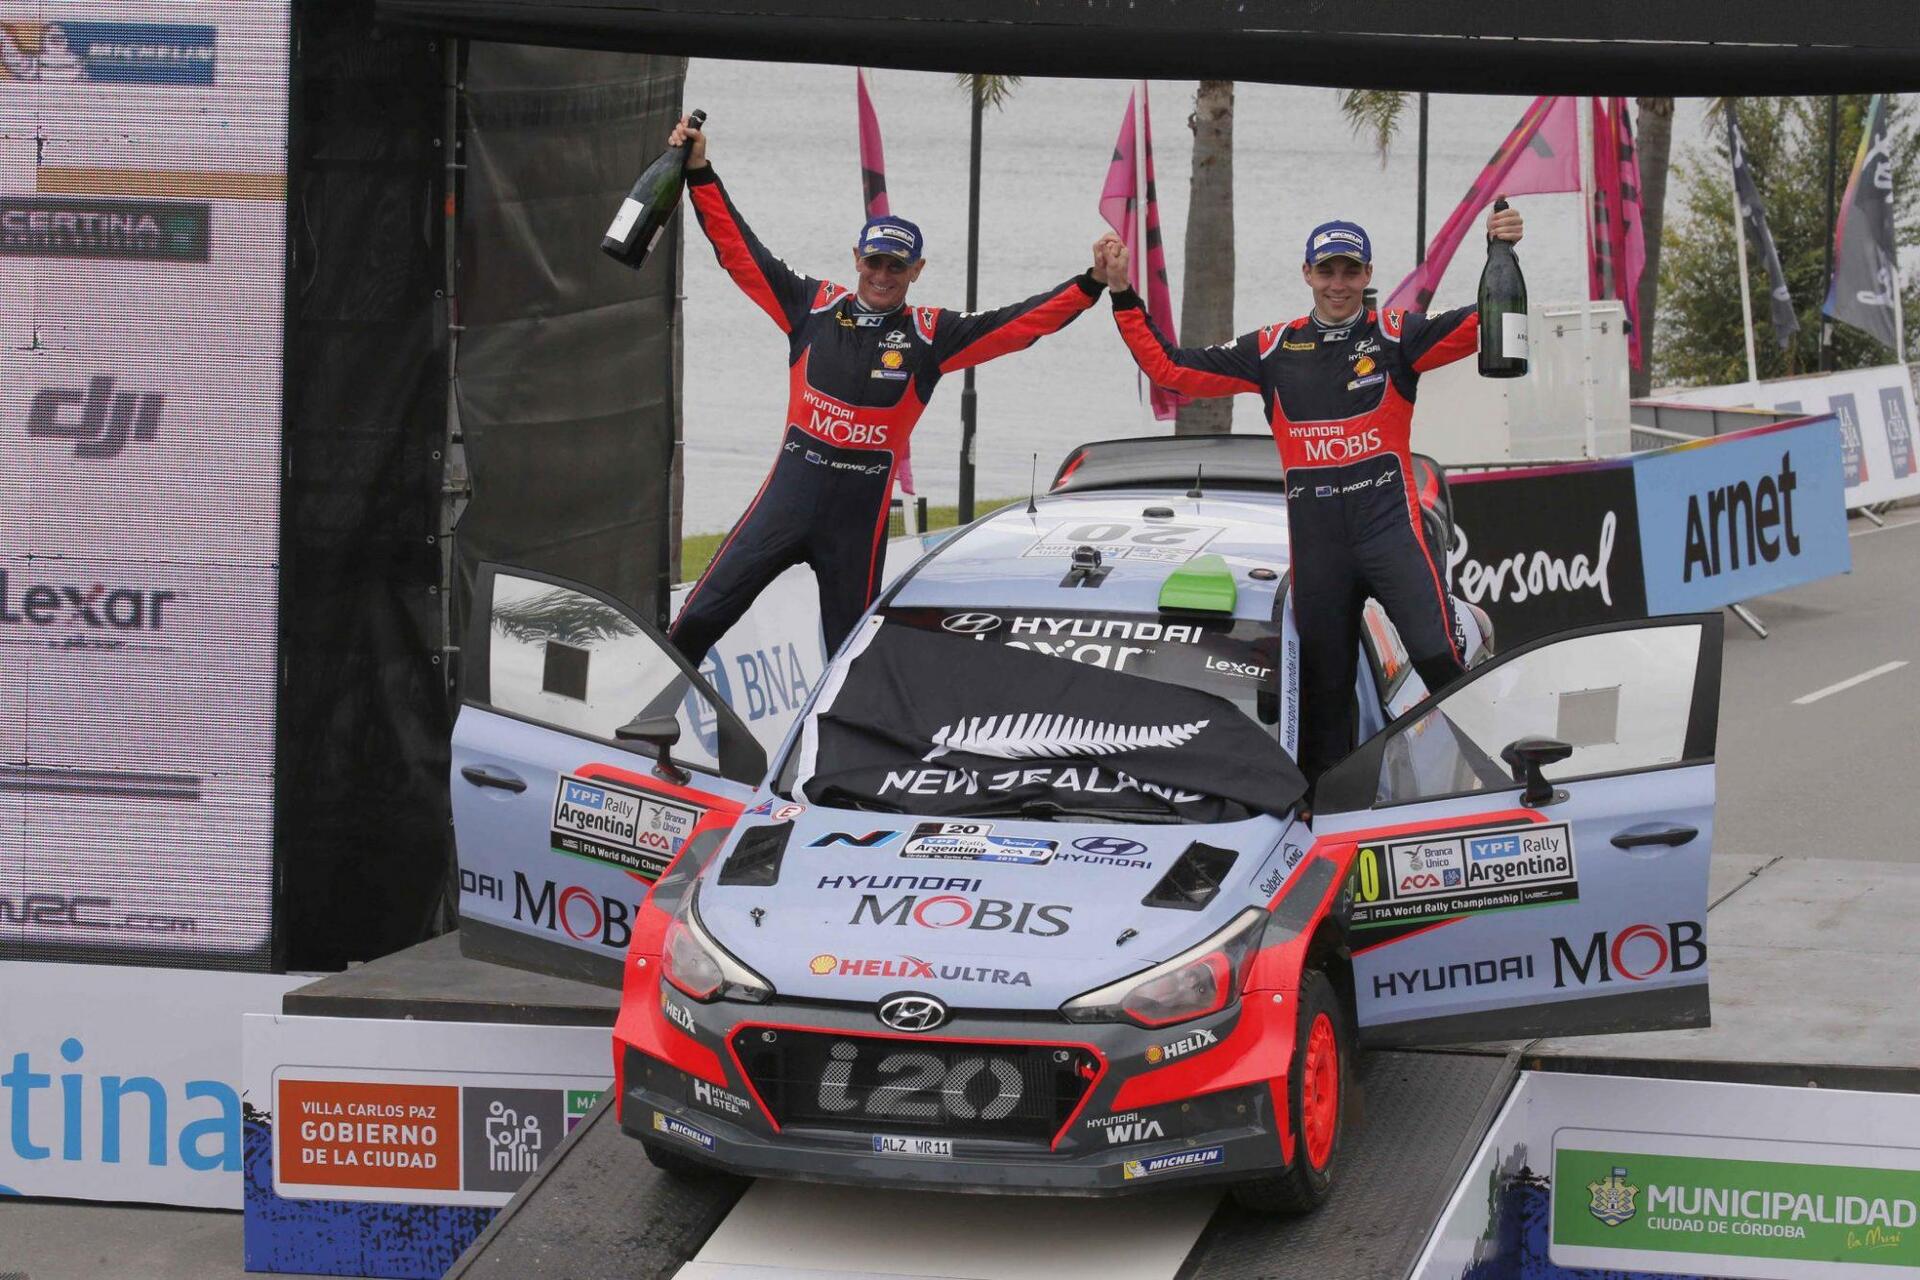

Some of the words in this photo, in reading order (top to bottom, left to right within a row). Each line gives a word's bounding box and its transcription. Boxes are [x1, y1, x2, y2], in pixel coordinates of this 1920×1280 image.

[802, 390, 855, 420] HYUNDAI
[808, 409, 889, 445] MOBIS
[1288, 426, 1345, 438] HYUNDAI
[1304, 427, 1383, 462] MOBIS
[1682, 451, 1801, 584] Arnet
[1445, 511, 1617, 607] Personal
[1010, 616, 1204, 644] HYUNDAI
[1205, 655, 1272, 678] Lexar
[736, 642, 811, 722] BNA
[1286, 639, 1299, 752] motorsport.hyundai.com
[876, 767, 980, 796] NEW
[569, 787, 601, 804] YPF
[604, 796, 634, 818] Rally
[558, 802, 634, 839] Argentina
[946, 825, 980, 835] 20
[583, 842, 597, 855] FIA
[597, 846, 619, 862] World
[620, 852, 641, 868] Rally
[914, 843, 988, 854] Argentina
[1424, 846, 1454, 858] Branca
[1474, 840, 1516, 856] YPF
[1522, 836, 1560, 854] Rally
[1053, 852, 1153, 870] HYUNDAI
[1425, 857, 1451, 869] Unico
[1469, 855, 1568, 883] Argentina
[816, 874, 983, 893] HYUNDAI
[847, 894, 1073, 937] MOBIS
[1375, 908, 1392, 920] FIA
[1393, 903, 1423, 917] World
[1424, 900, 1449, 915] Rally
[1451, 893, 1520, 910] Championship
[838, 955, 938, 980] HELIX
[931, 964, 1032, 988] ULTRA
[1372, 954, 1535, 999] HYUNDAI
[665, 1000, 697, 1035] HELIX
[1163, 1028, 1219, 1060] HELIX
[301, 1101, 343, 1116] VILLA
[348, 1103, 404, 1118] CARLOS
[409, 1105, 436, 1119] PAZ
[711, 1085, 751, 1110] HYUNDAI
[712, 1097, 743, 1116] STEEL
[301, 1120, 437, 1146] GOBIERNO
[669, 1120, 712, 1146] MICHELIN
[1086, 1112, 1139, 1129] HYUNDAI
[302, 1147, 328, 1165] DE
[333, 1149, 358, 1166] LA
[363, 1150, 437, 1169] CIUDAD
[882, 1138, 907, 1152] ALZ
[1149, 1149, 1219, 1171] MICHELIN
[1646, 1183, 1918, 1228] MUNICIPALIDAD
[1647, 1216, 1704, 1233] CIUDAD
[1708, 1219, 1729, 1234] DE
[1731, 1219, 1806, 1239] CÓRDOBA
